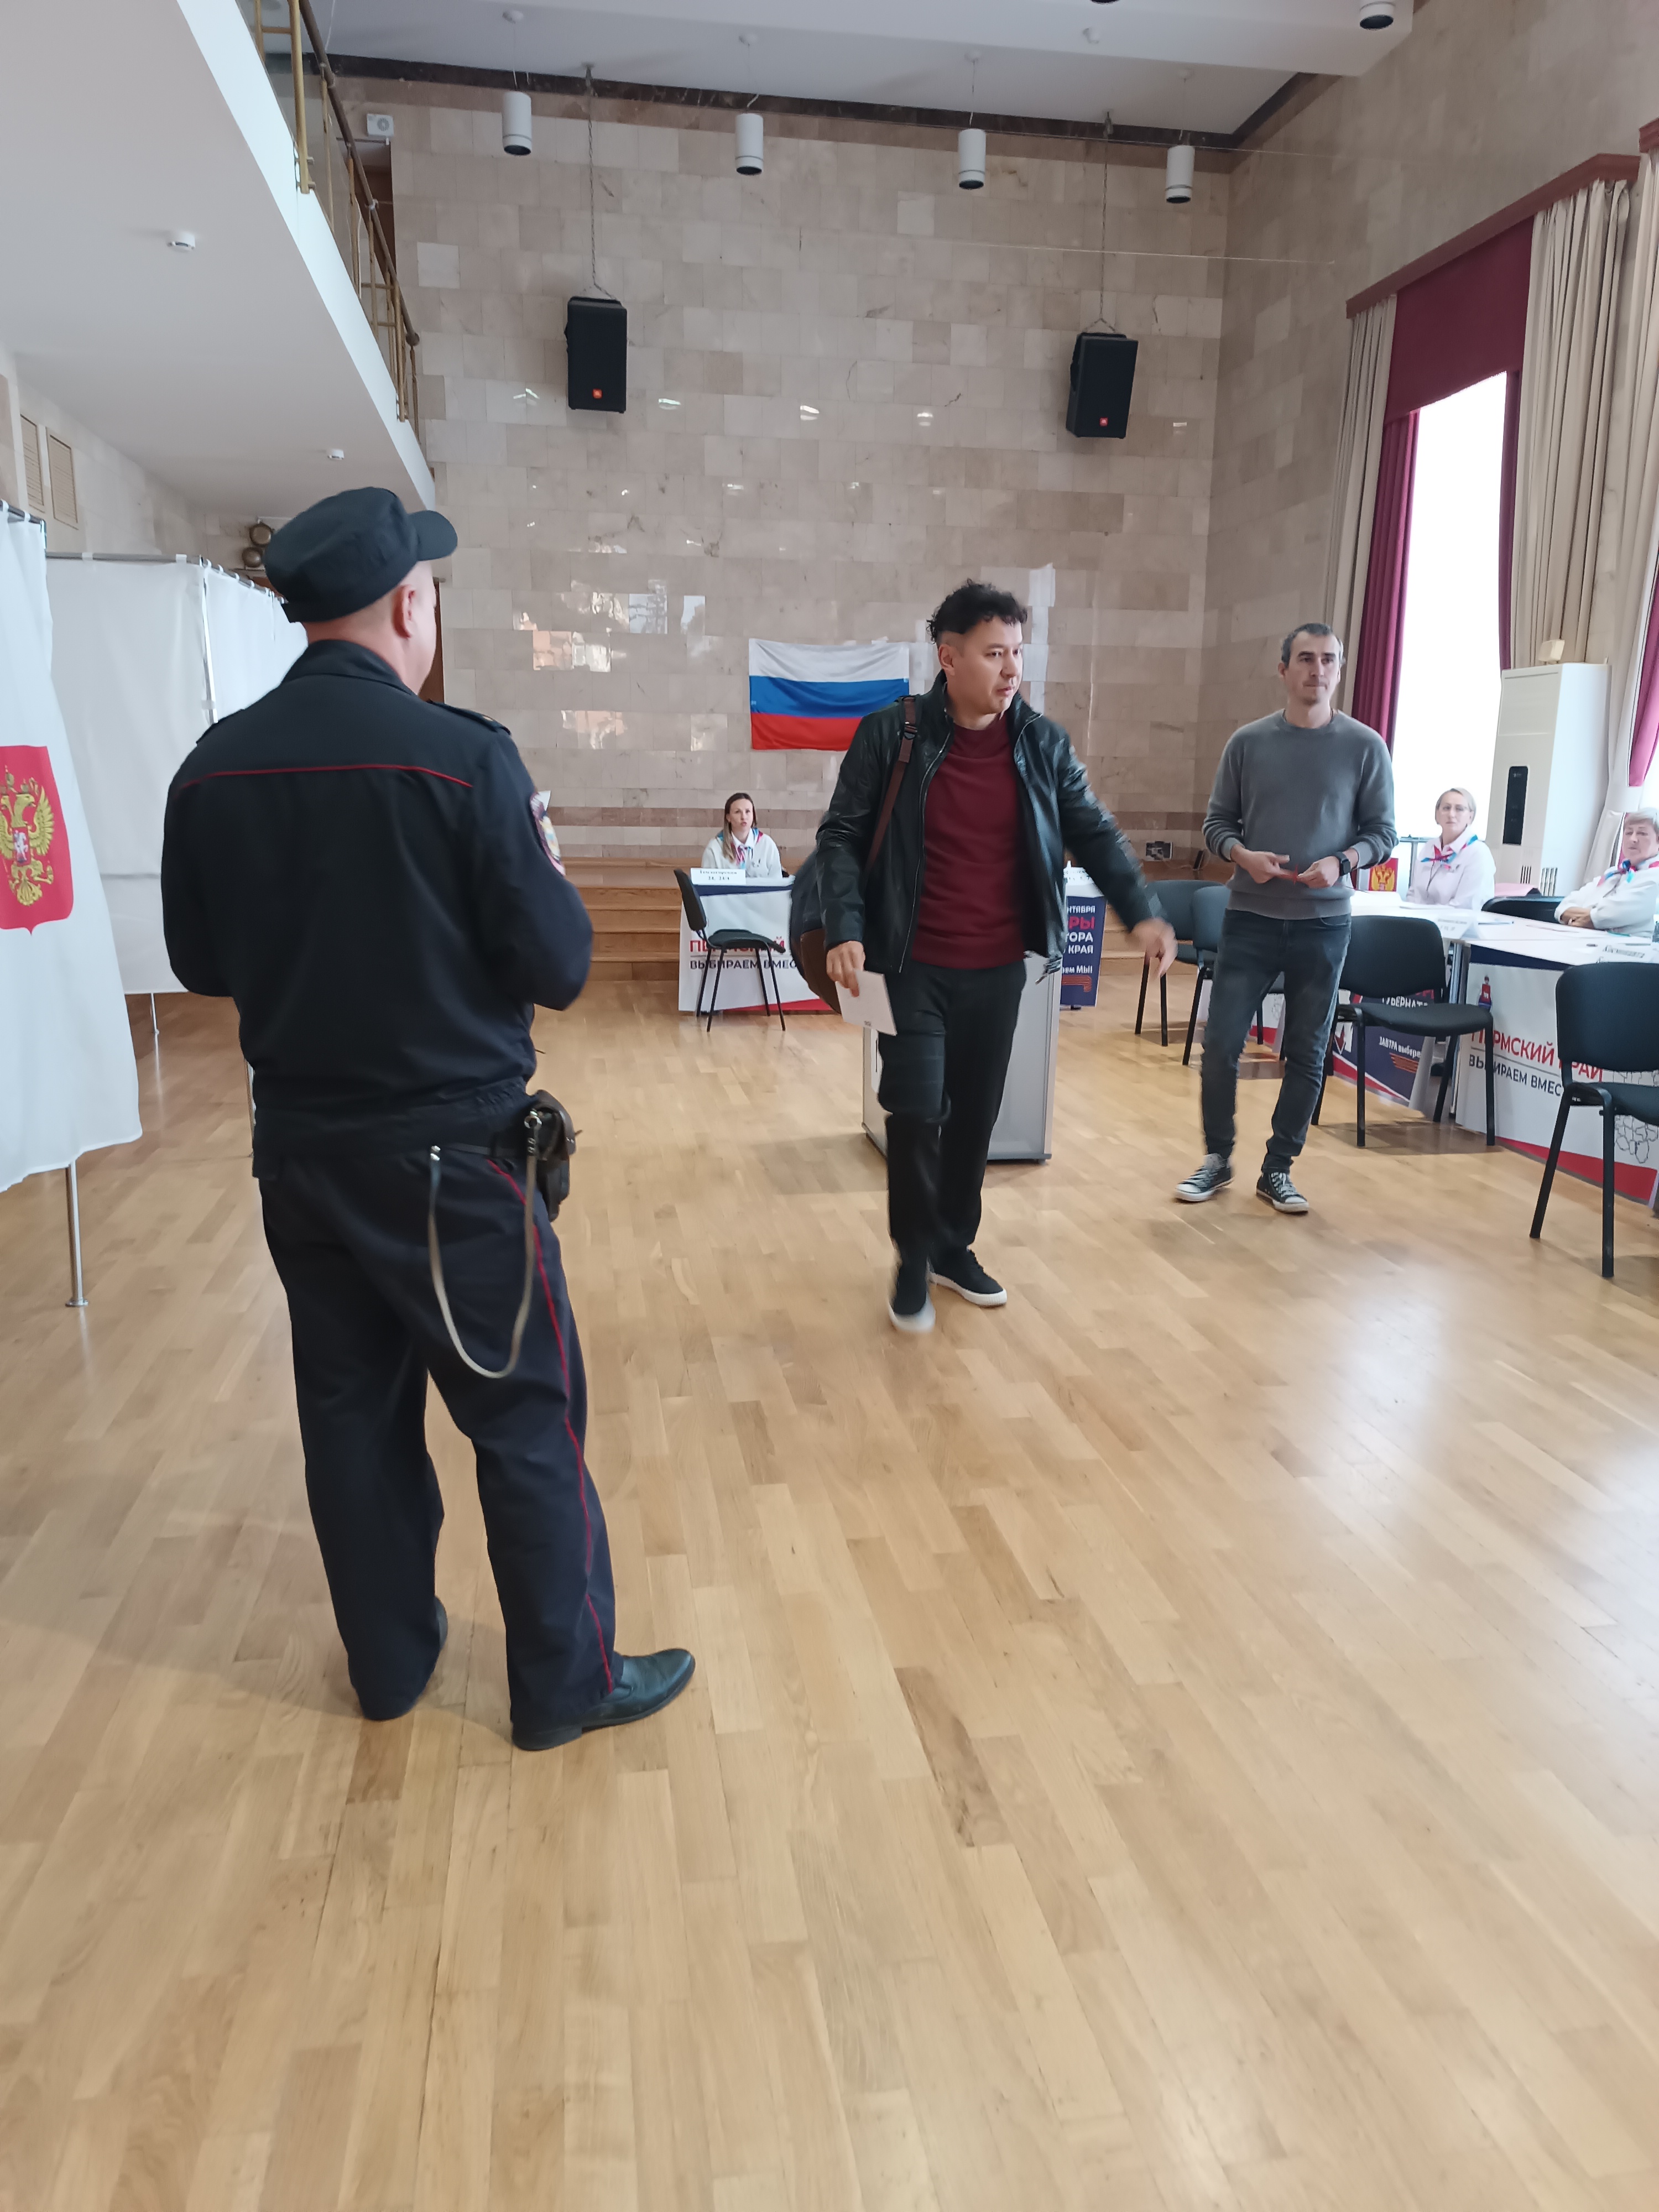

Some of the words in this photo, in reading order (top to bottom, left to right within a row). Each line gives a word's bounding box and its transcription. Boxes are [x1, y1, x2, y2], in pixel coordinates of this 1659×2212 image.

[1068, 945, 1093, 954] КРАЯ
[1471, 1029, 1555, 1067] ПРМСКИЙ
[1469, 1054, 1527, 1086] ВЫИРАЕМ
[1531, 1074, 1562, 1097] ВМЕС
